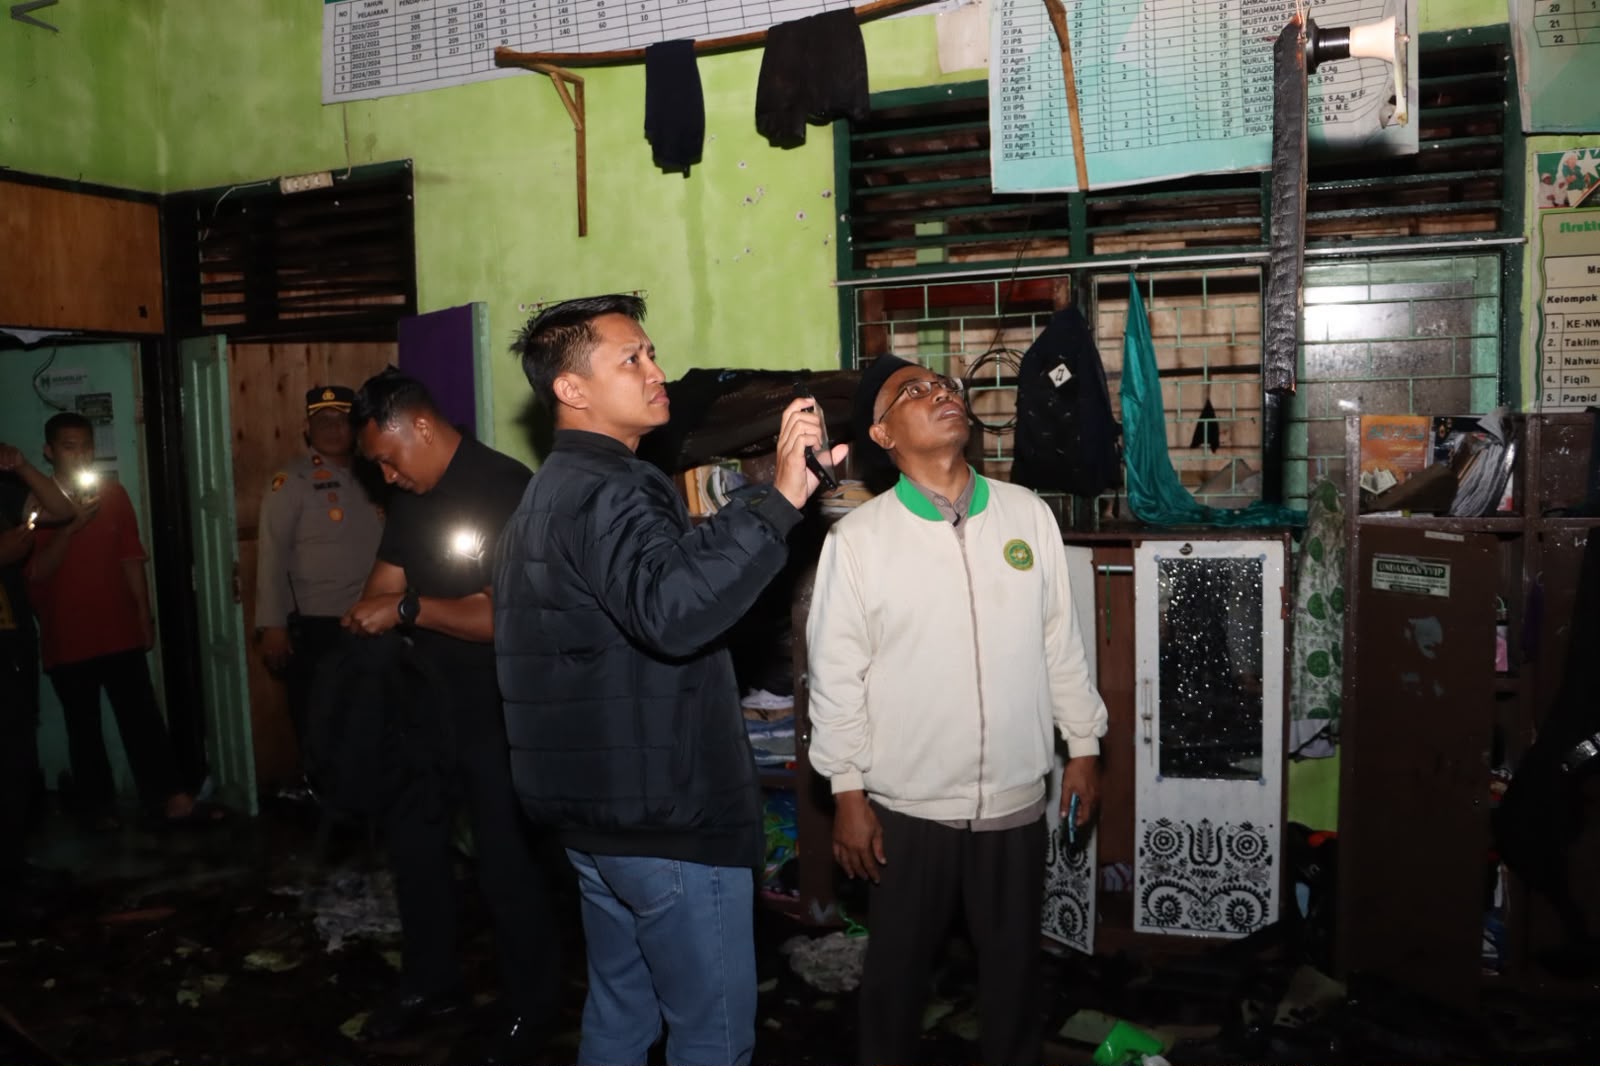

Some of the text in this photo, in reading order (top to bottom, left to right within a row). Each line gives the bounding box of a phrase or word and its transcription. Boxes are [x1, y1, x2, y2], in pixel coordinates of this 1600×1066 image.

[1242, 4, 1286, 16] MUHAMMAD
[1550, 4, 1560, 12] 20
[358, 9, 389, 19] PELAJARAN
[352, 21, 380, 31] 2019/2020
[1550, 19, 1560, 28] 21
[352, 31, 380, 40] 2020/2021
[1553, 35, 1564, 43] 22
[352, 40, 380, 50] 2021/2022
[352, 50, 381, 60] 2022/2023
[352, 60, 381, 69] 2023/2024
[1010, 57, 1025, 65] Agm
[352, 70, 381, 79] 2024/2025
[1010, 67, 1025, 75] Agm
[352, 80, 381, 89] 2025/2026
[1010, 86, 1026, 94] Agm
[1014, 133, 1030, 141] Agm
[1014, 142, 1030, 150] Agm
[1547, 294, 1597, 303] Kelompok
[1551, 321, 1559, 329] 1.
[1564, 338, 1599, 346] Taklim
[1548, 356, 1556, 364] 3.
[1564, 376, 1590, 385] Fiqih
[1378, 562, 1421, 574] UNDANGAN
